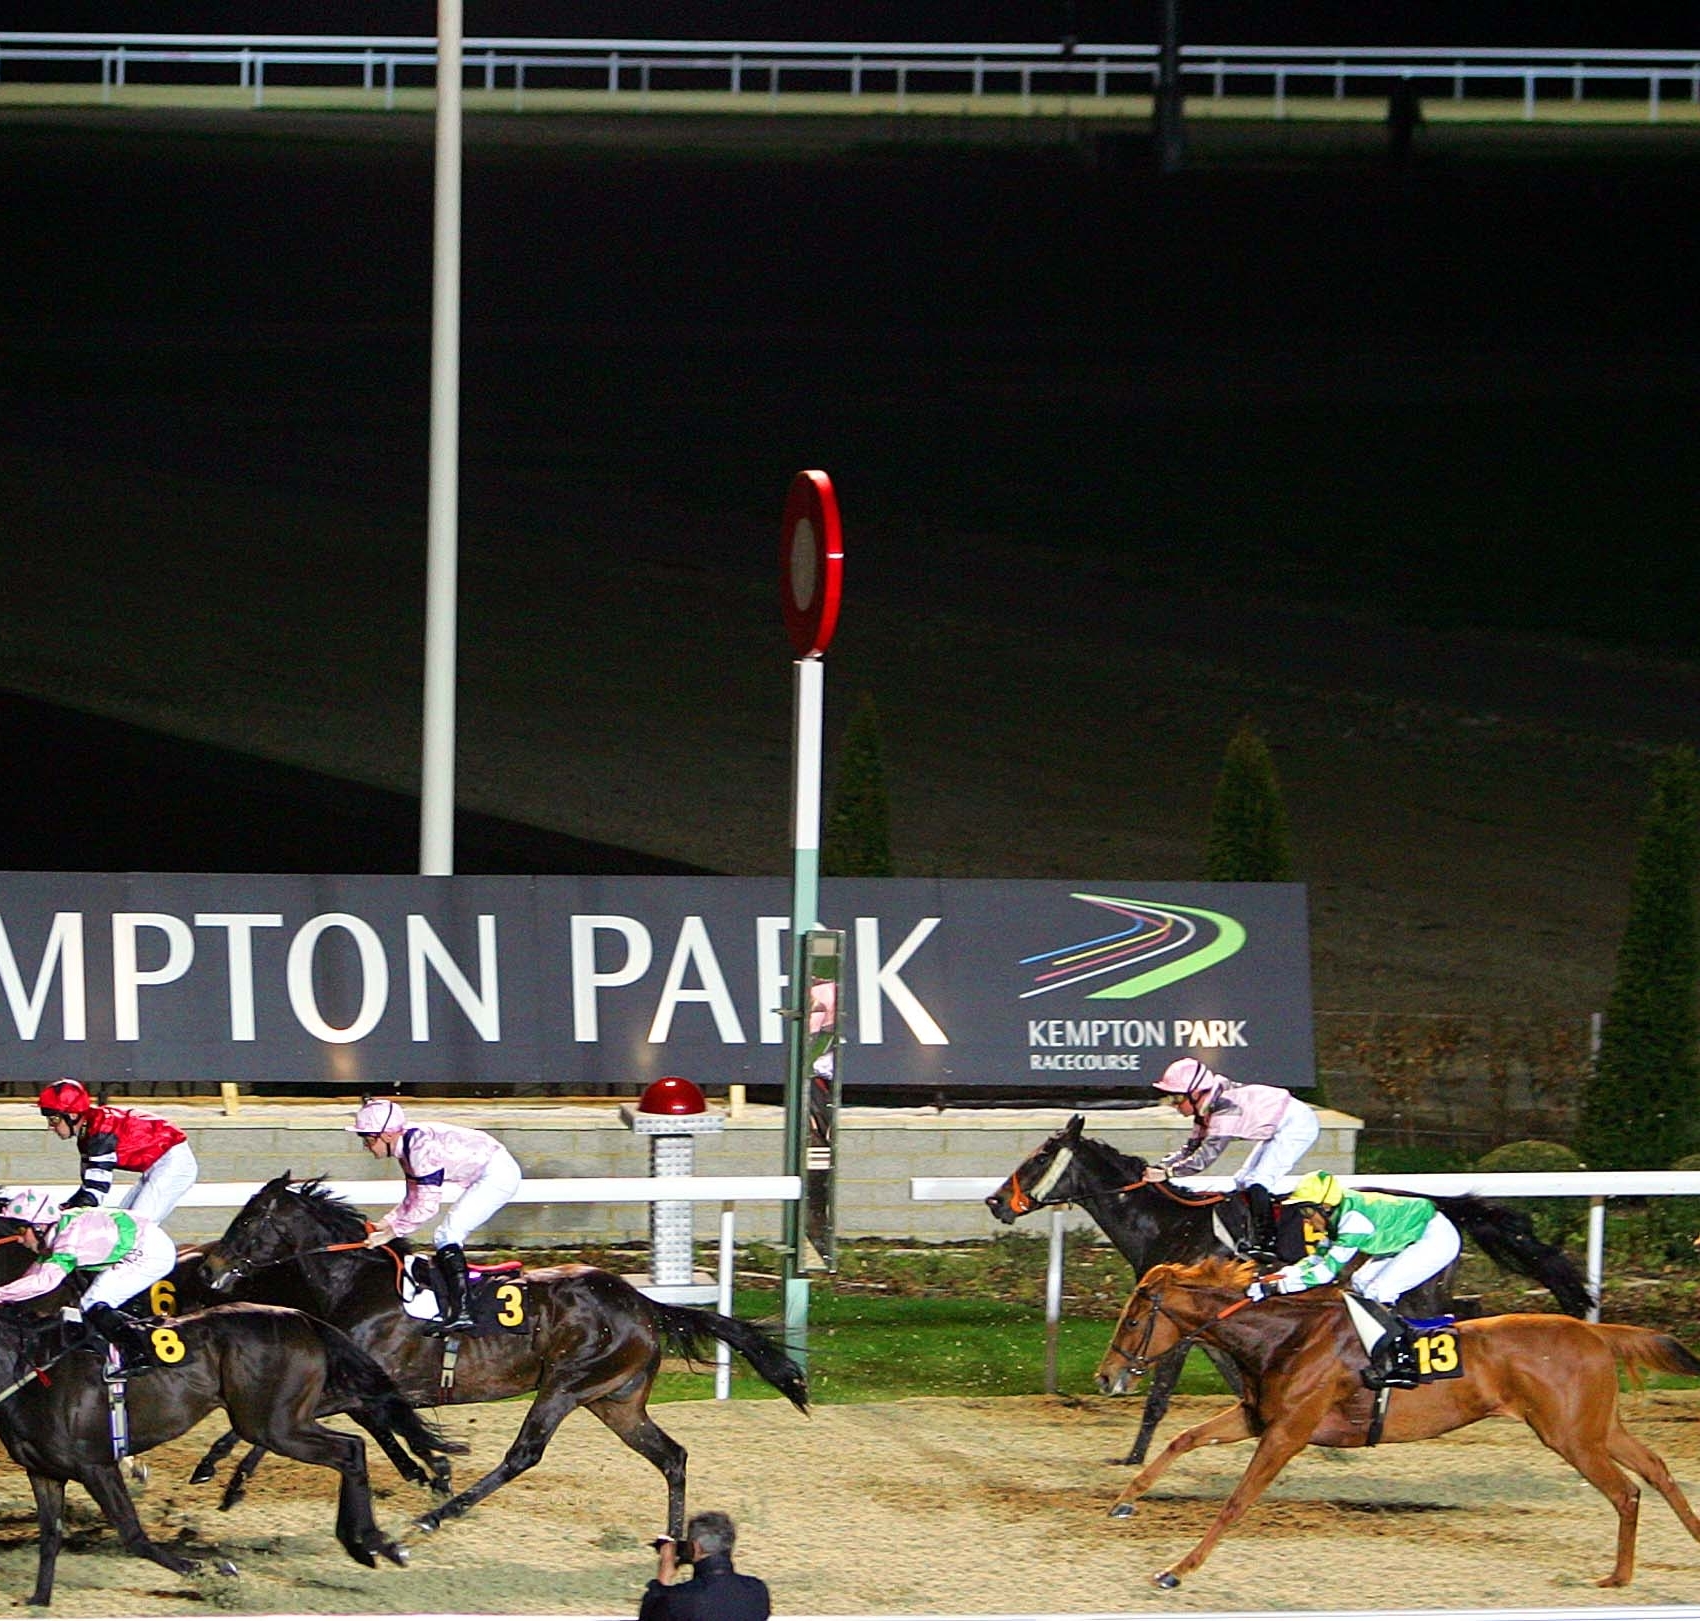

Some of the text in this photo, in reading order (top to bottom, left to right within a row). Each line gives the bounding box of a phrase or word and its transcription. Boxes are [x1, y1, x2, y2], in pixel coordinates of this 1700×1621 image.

[1028, 1020, 1248, 1047] KEMPTON PARK
[1030, 1053, 1141, 1070] RACECOURSE
[150, 1280, 177, 1317] 6
[496, 1285, 524, 1327] 3
[151, 1328, 186, 1363] 8
[1413, 1334, 1459, 1374] 13
